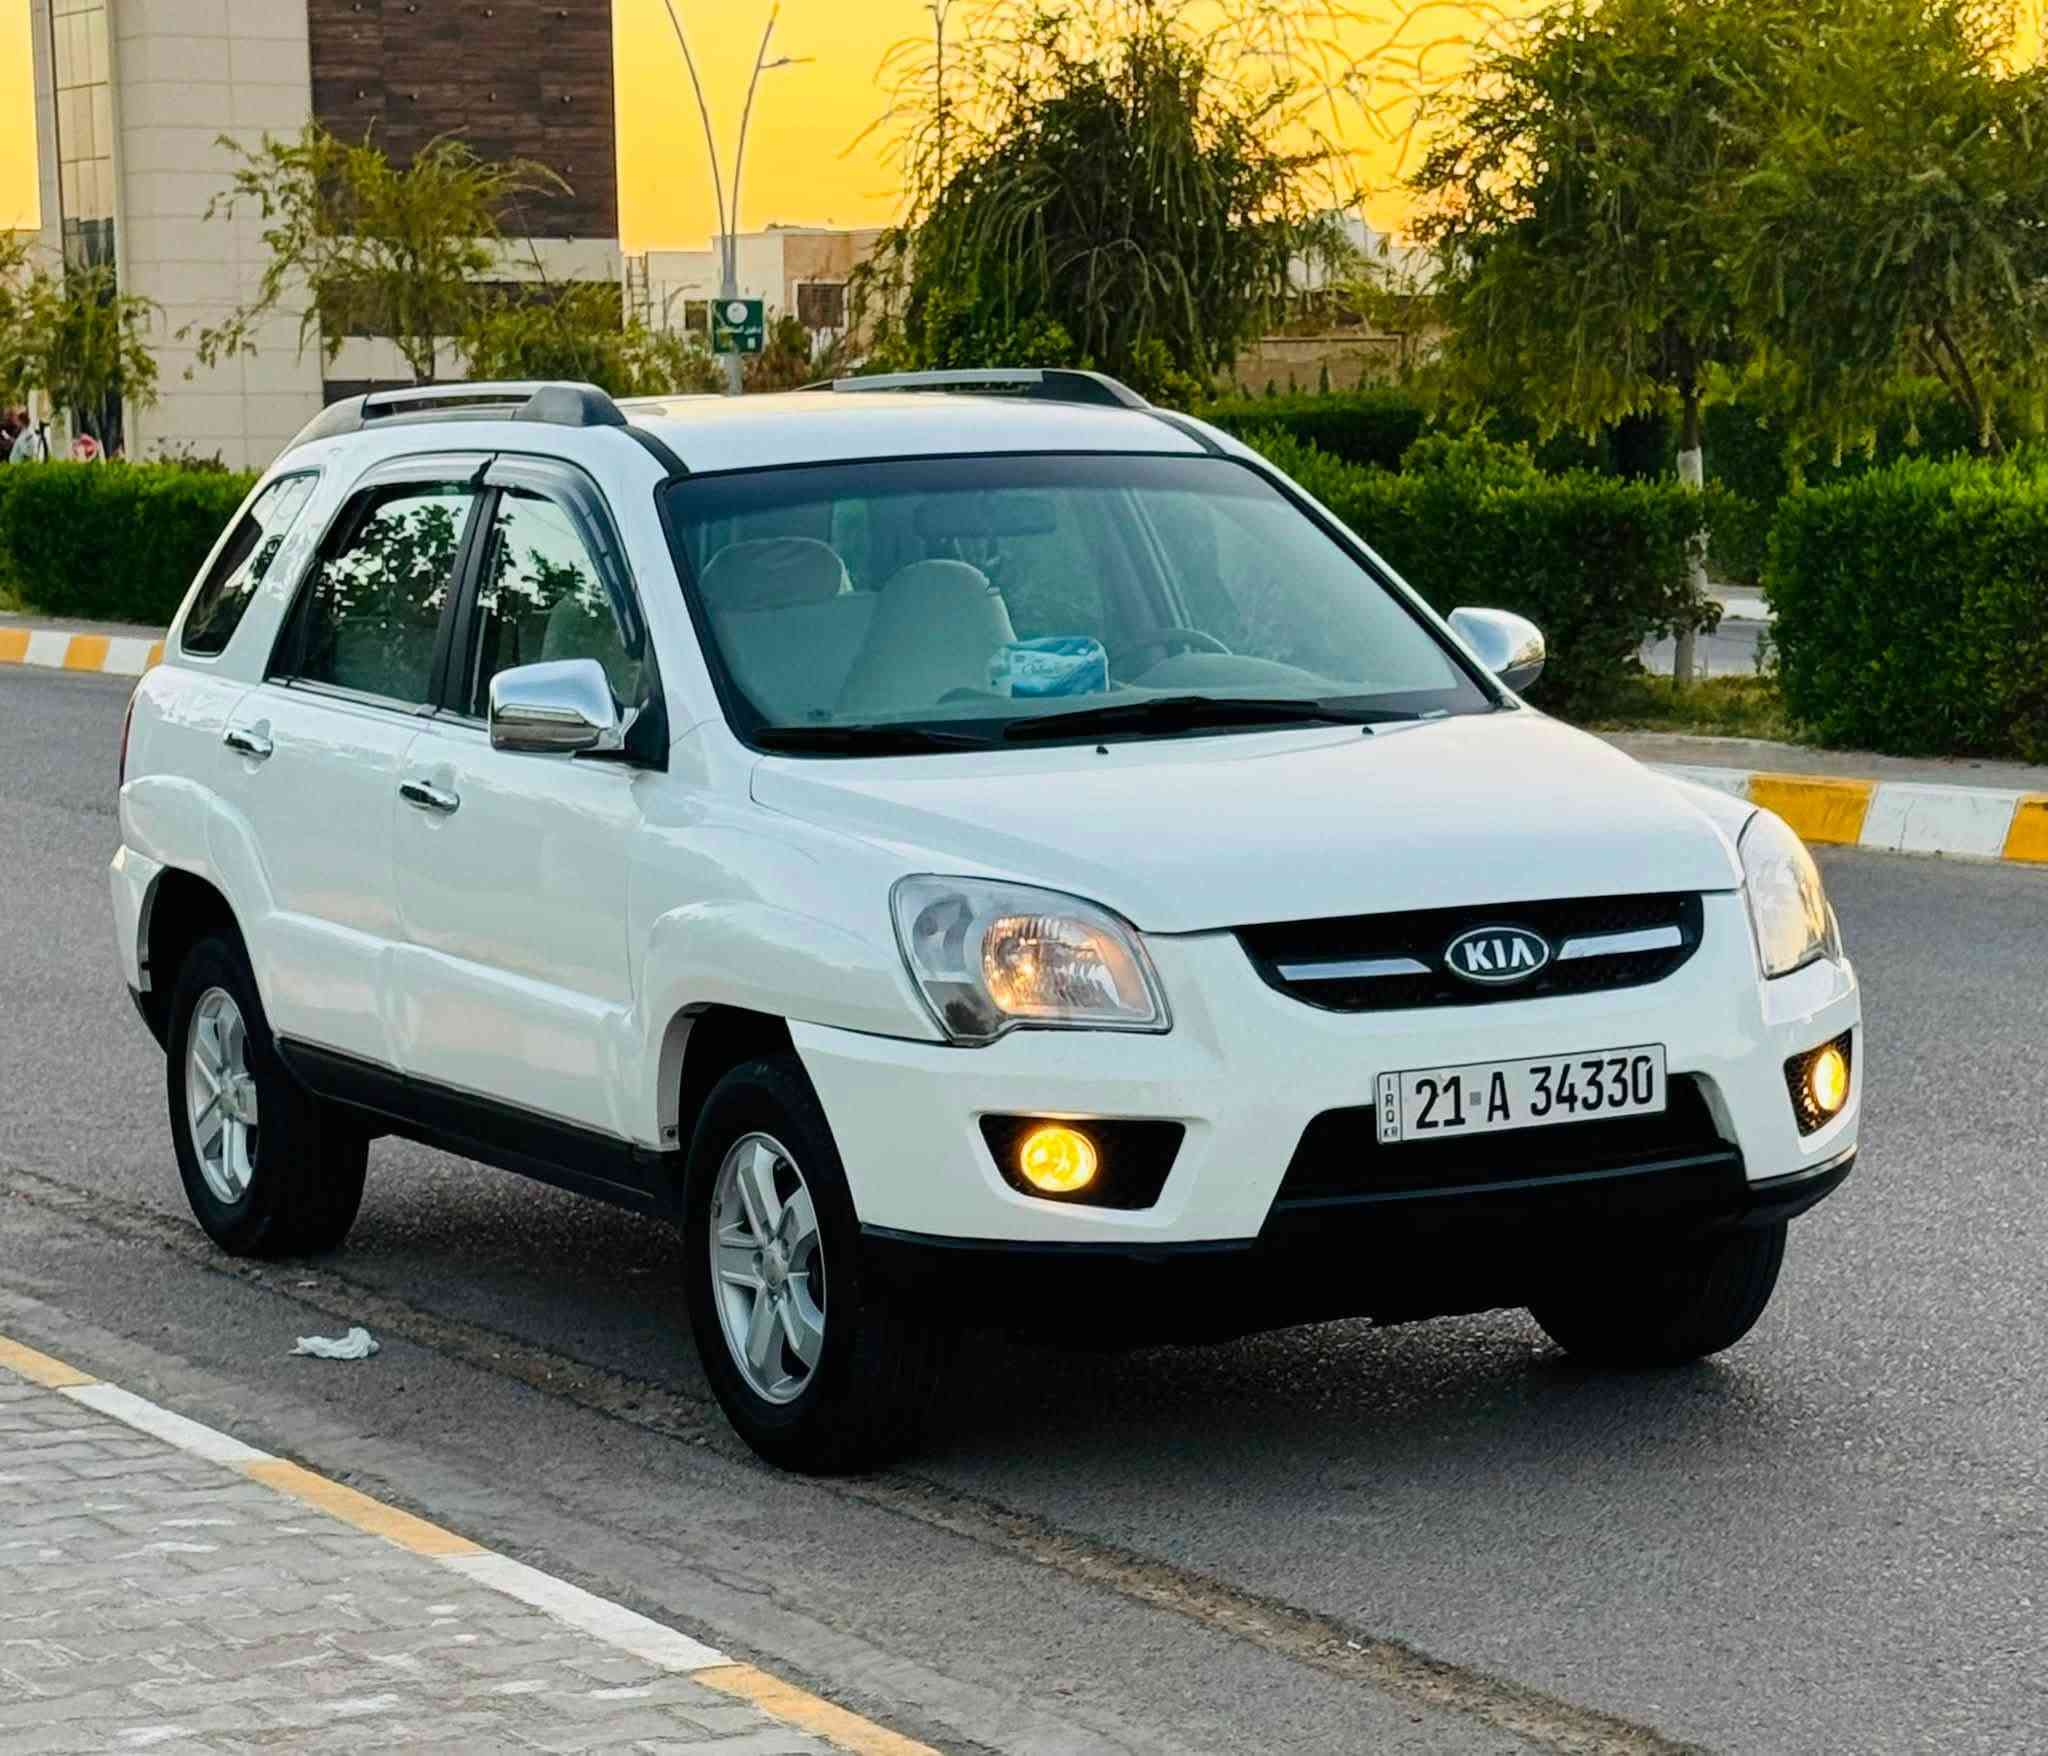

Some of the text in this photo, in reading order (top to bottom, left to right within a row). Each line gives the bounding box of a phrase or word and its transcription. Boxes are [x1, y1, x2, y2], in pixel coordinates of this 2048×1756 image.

[1463, 937, 1536, 972] KIA
[1415, 1055, 1653, 1130] 21 A 34330
